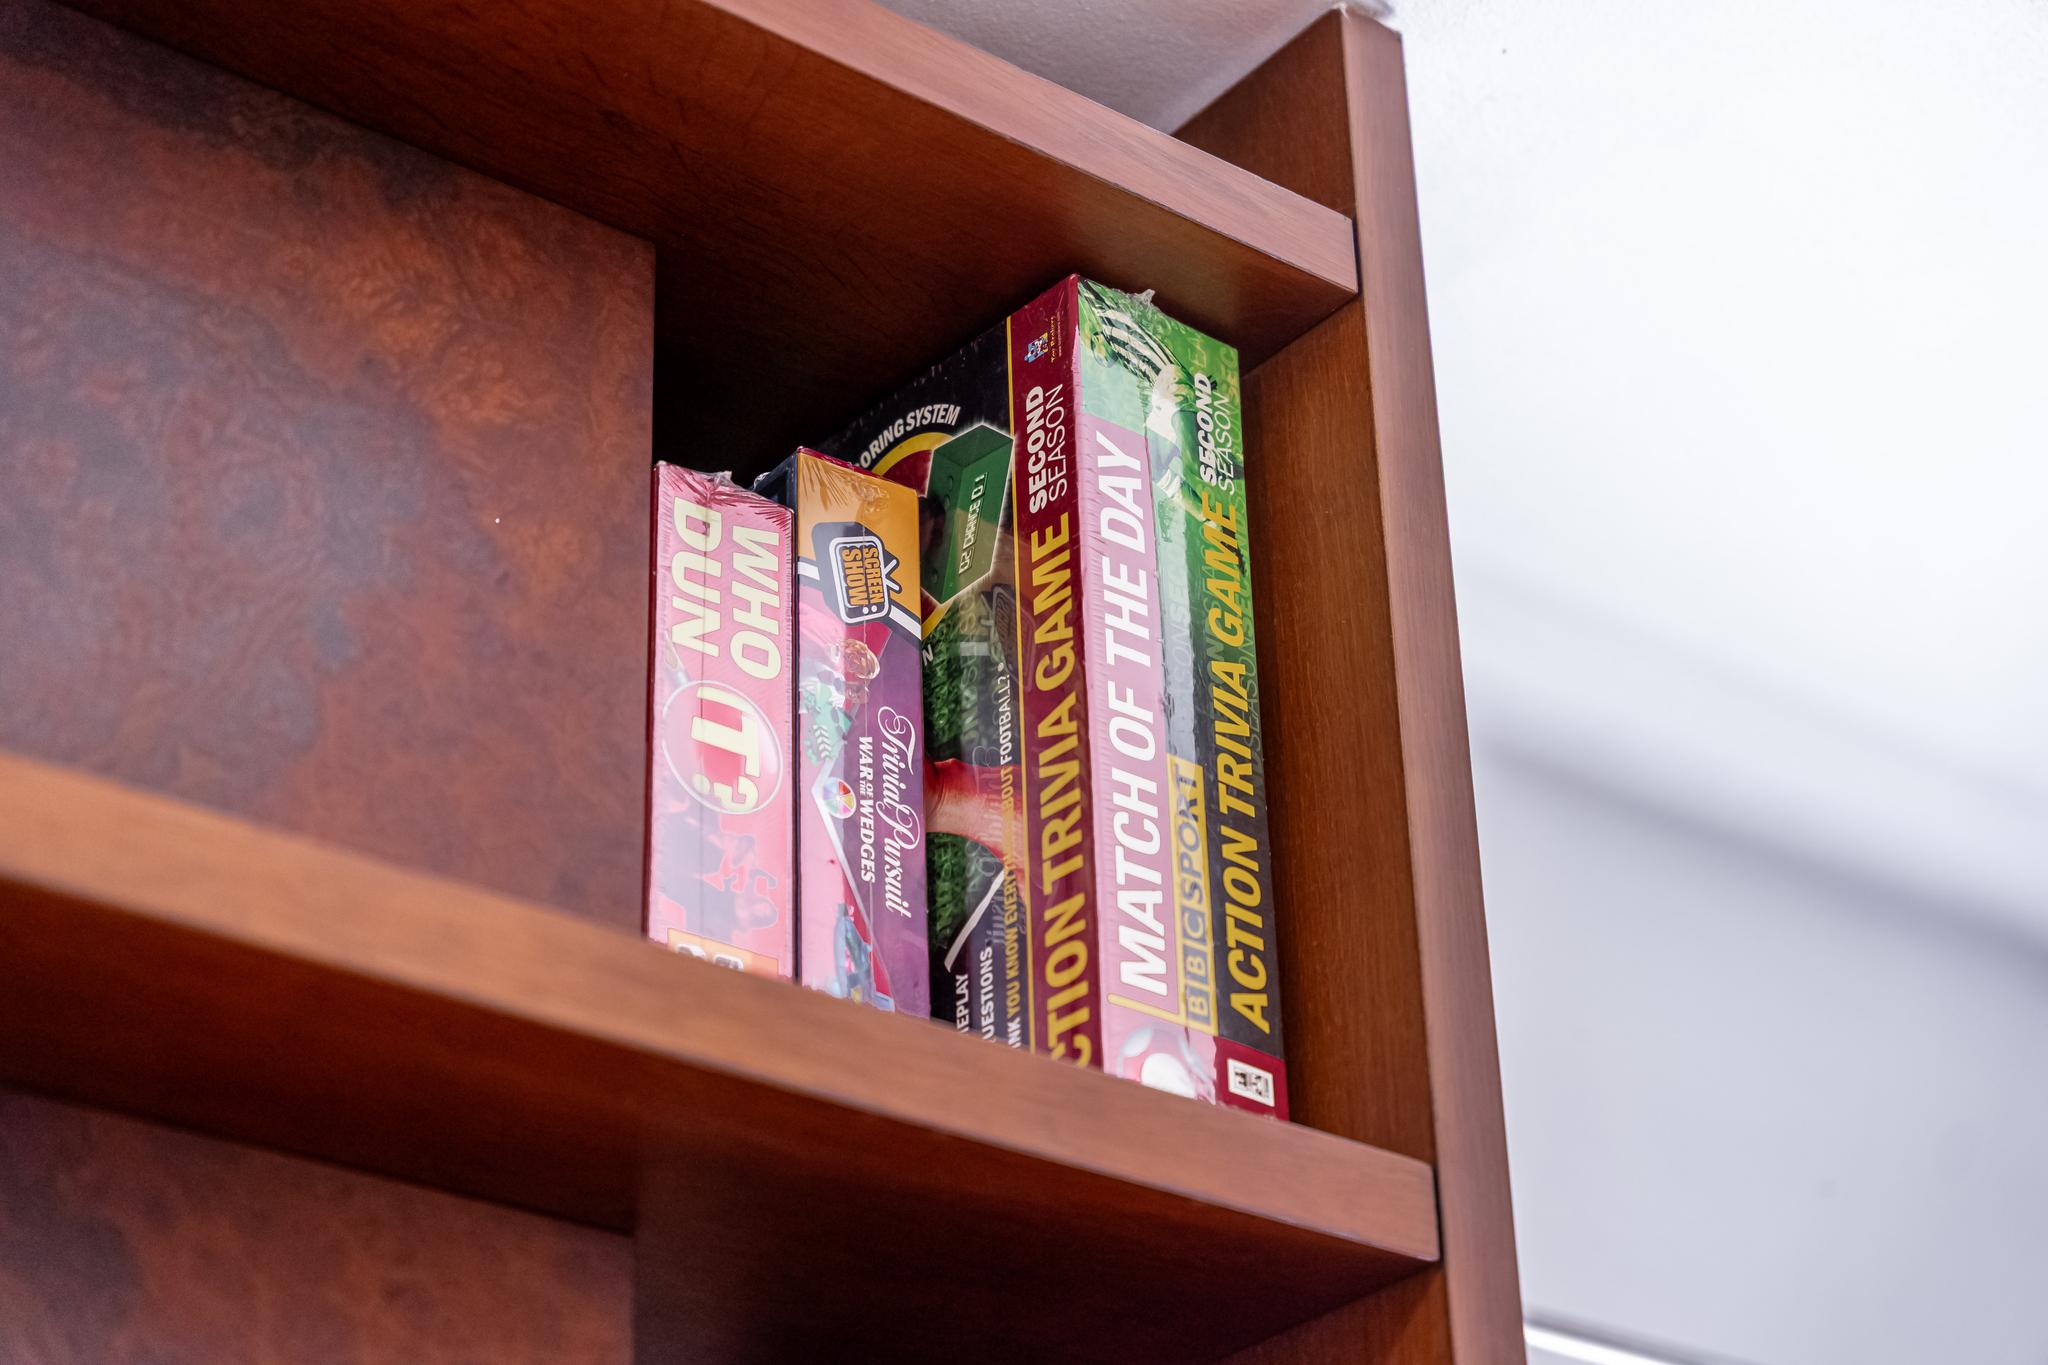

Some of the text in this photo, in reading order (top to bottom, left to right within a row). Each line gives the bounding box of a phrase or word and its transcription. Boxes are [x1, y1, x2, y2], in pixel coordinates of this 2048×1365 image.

[859, 403, 961, 469] ORING SYSTEM
[1026, 385, 1047, 514] SECOND
[1047, 383, 1070, 502] SEASON
[1194, 372, 1218, 487] SECOND
[1213, 392, 1236, 496] SEASON
[671, 496, 722, 658] DUN
[730, 526, 782, 680] WHO
[842, 548, 869, 605] SHOW
[863, 547, 884, 603] SCREEN
[1202, 491, 1246, 648] GAME
[998, 674, 1014, 766] FOOTBALL?
[1096, 429, 1168, 997] MATCH OF THE DAY
[1211, 660, 1257, 819] TRIVIA
[859, 736, 876, 883] WAR OF THE WEDGES
[875, 705, 920, 918] Trivial Pursuit
[1031, 511, 1092, 1069] CTION TRIVIA GAME
[1004, 927, 1020, 979] KNOW
[1174, 763, 1210, 1025] BBC SPORT
[1219, 823, 1271, 1036] ACTION
[955, 974, 970, 1033] EPLAY
[979, 946, 996, 1041] UESTIONS
[1005, 981, 1021, 1017] YOU
[1007, 1016, 1021, 1048] INK
